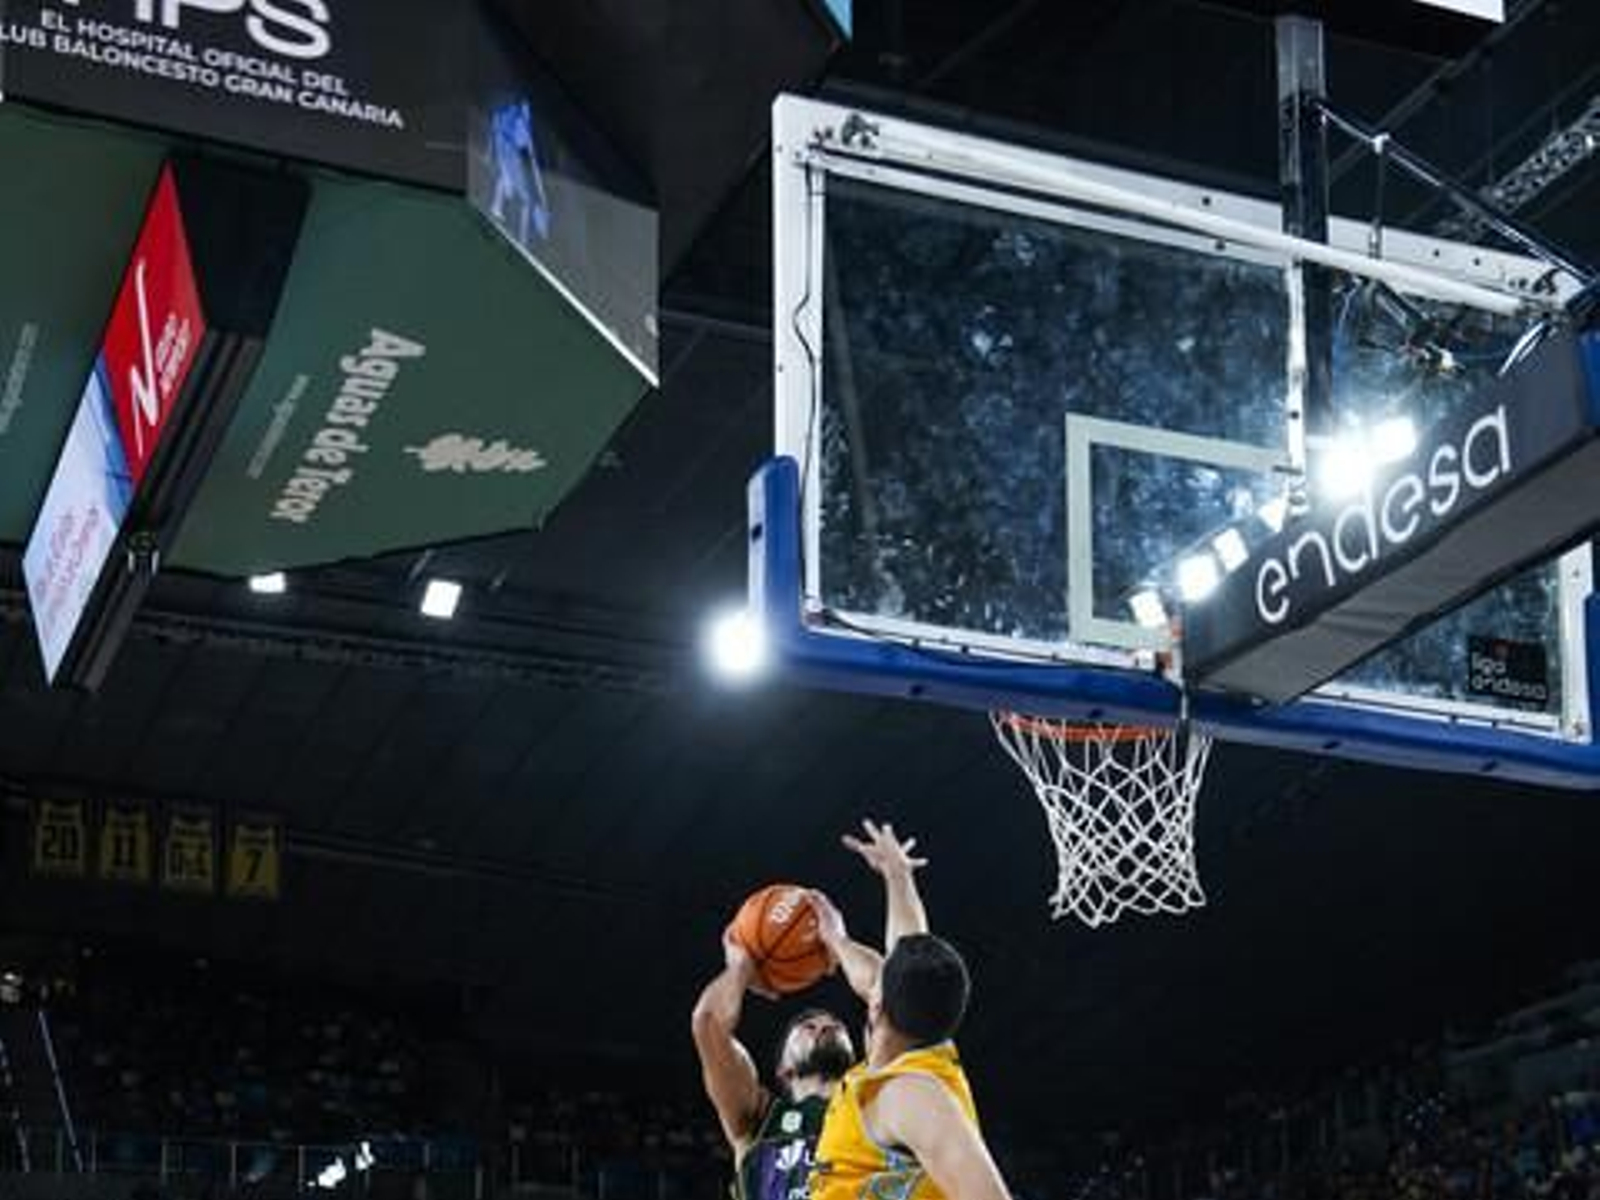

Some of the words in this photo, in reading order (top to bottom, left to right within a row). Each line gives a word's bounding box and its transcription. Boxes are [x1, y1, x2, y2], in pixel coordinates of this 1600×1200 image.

[41, 8, 72, 33] EL
[77, 18, 199, 63] HOSPITAL
[203, 47, 299, 84] OFICIAL
[302, 70, 349, 96] DEL
[53, 34, 219, 88] BALONCESTO
[223, 74, 292, 104] GRAN
[298, 90, 404, 128] CANARIA
[326, 327, 426, 427] Aguas
[304, 427, 369, 465] de
[269, 466, 352, 523] Teror
[1256, 404, 1511, 624] endesa
[1471, 675, 1547, 700] endesa
[1472, 652, 1507, 677] liga
